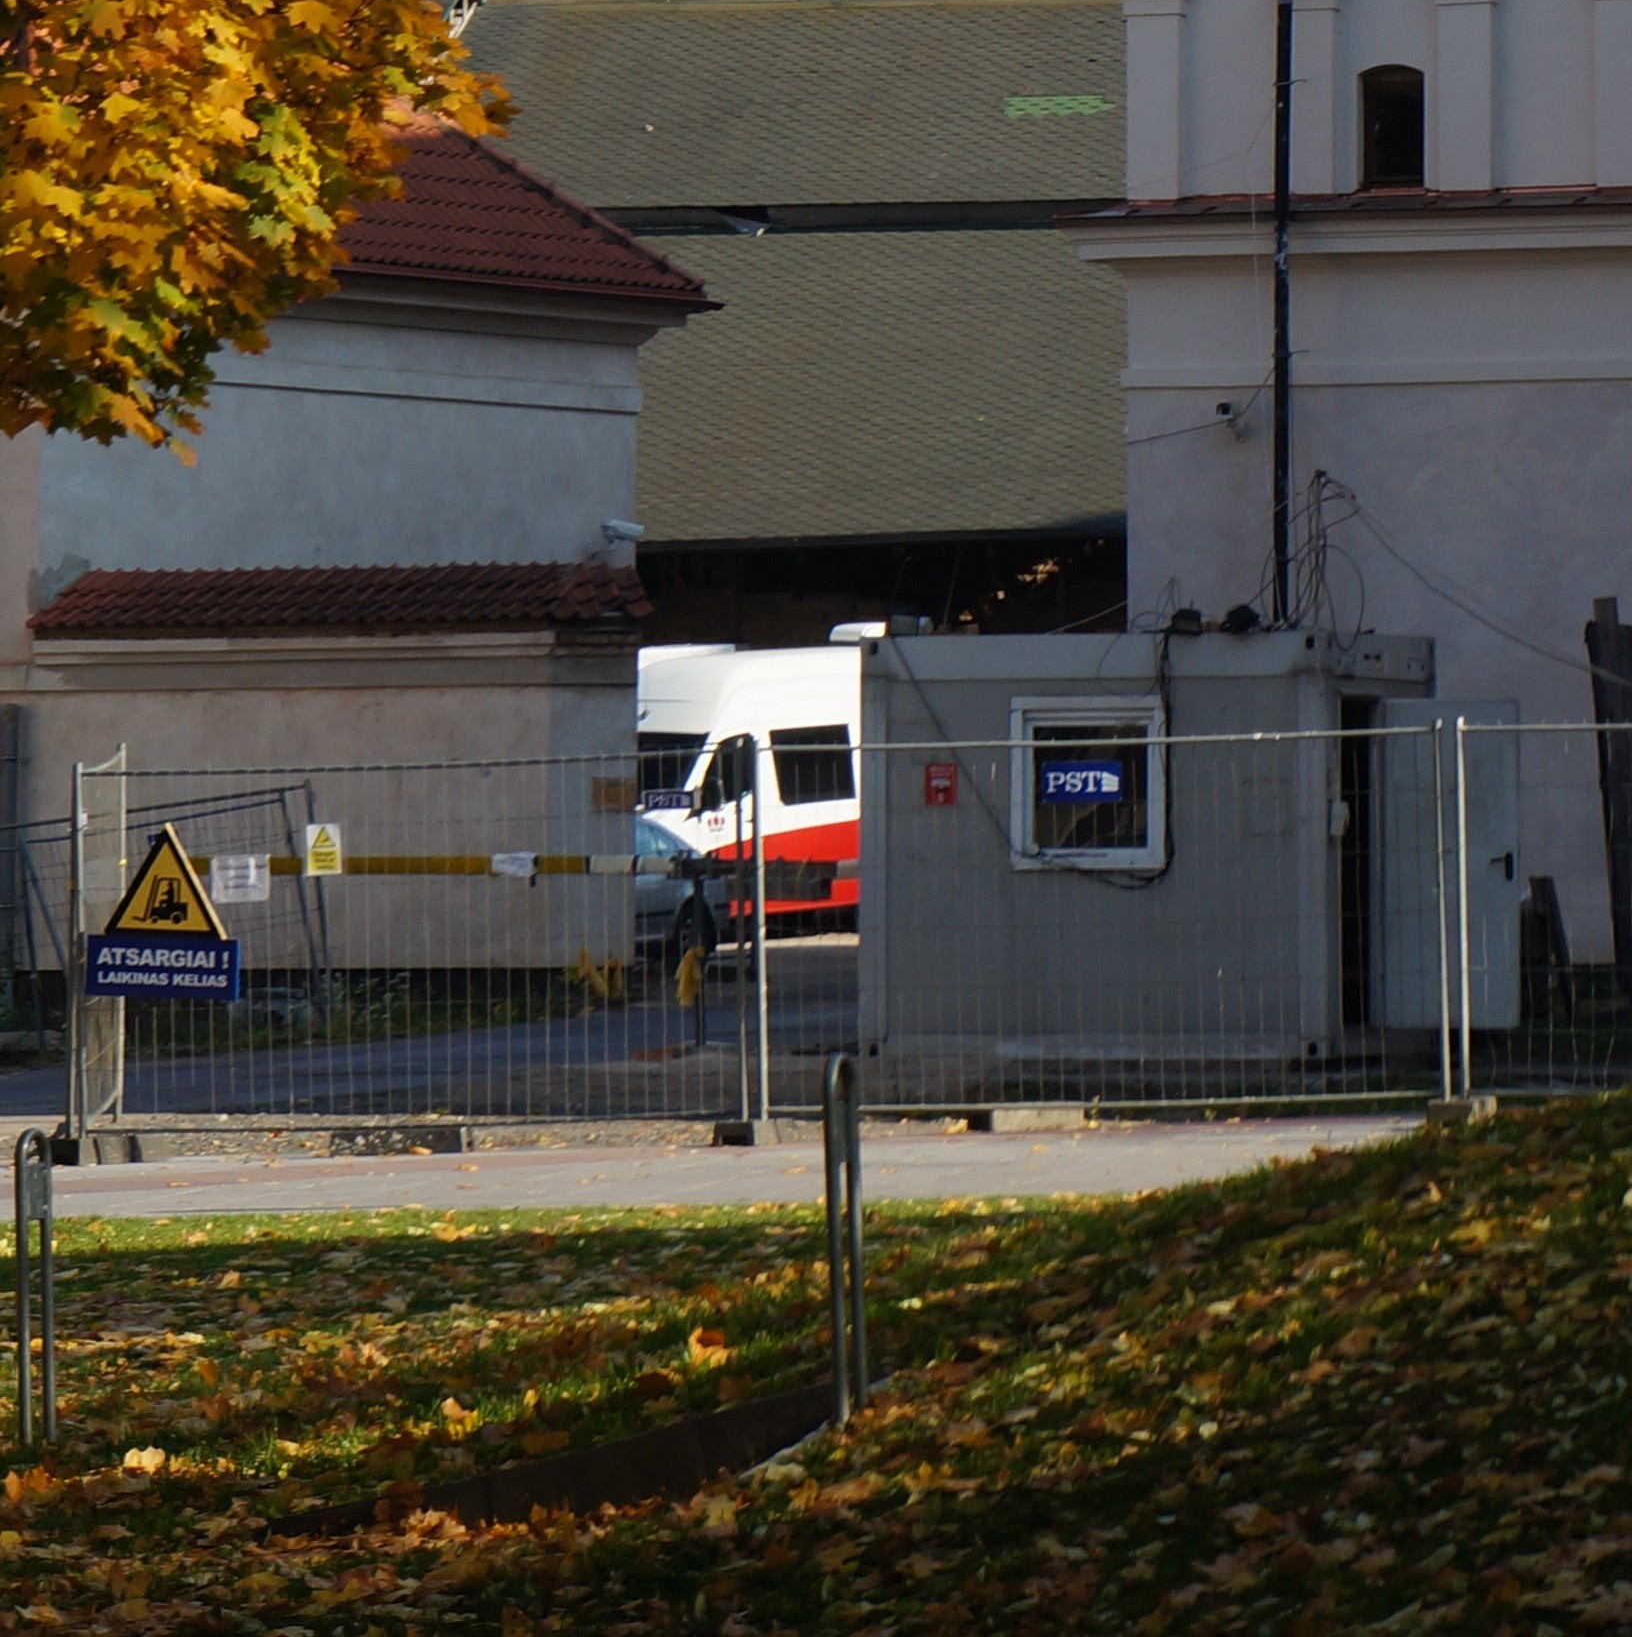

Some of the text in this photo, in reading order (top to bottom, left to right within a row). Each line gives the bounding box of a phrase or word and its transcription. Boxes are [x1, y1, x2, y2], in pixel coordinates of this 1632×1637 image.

[1045, 770, 1101, 794] PST
[97, 947, 216, 968] ATSARGIAI
[97, 971, 228, 988] LAIKINAS KELIAS
